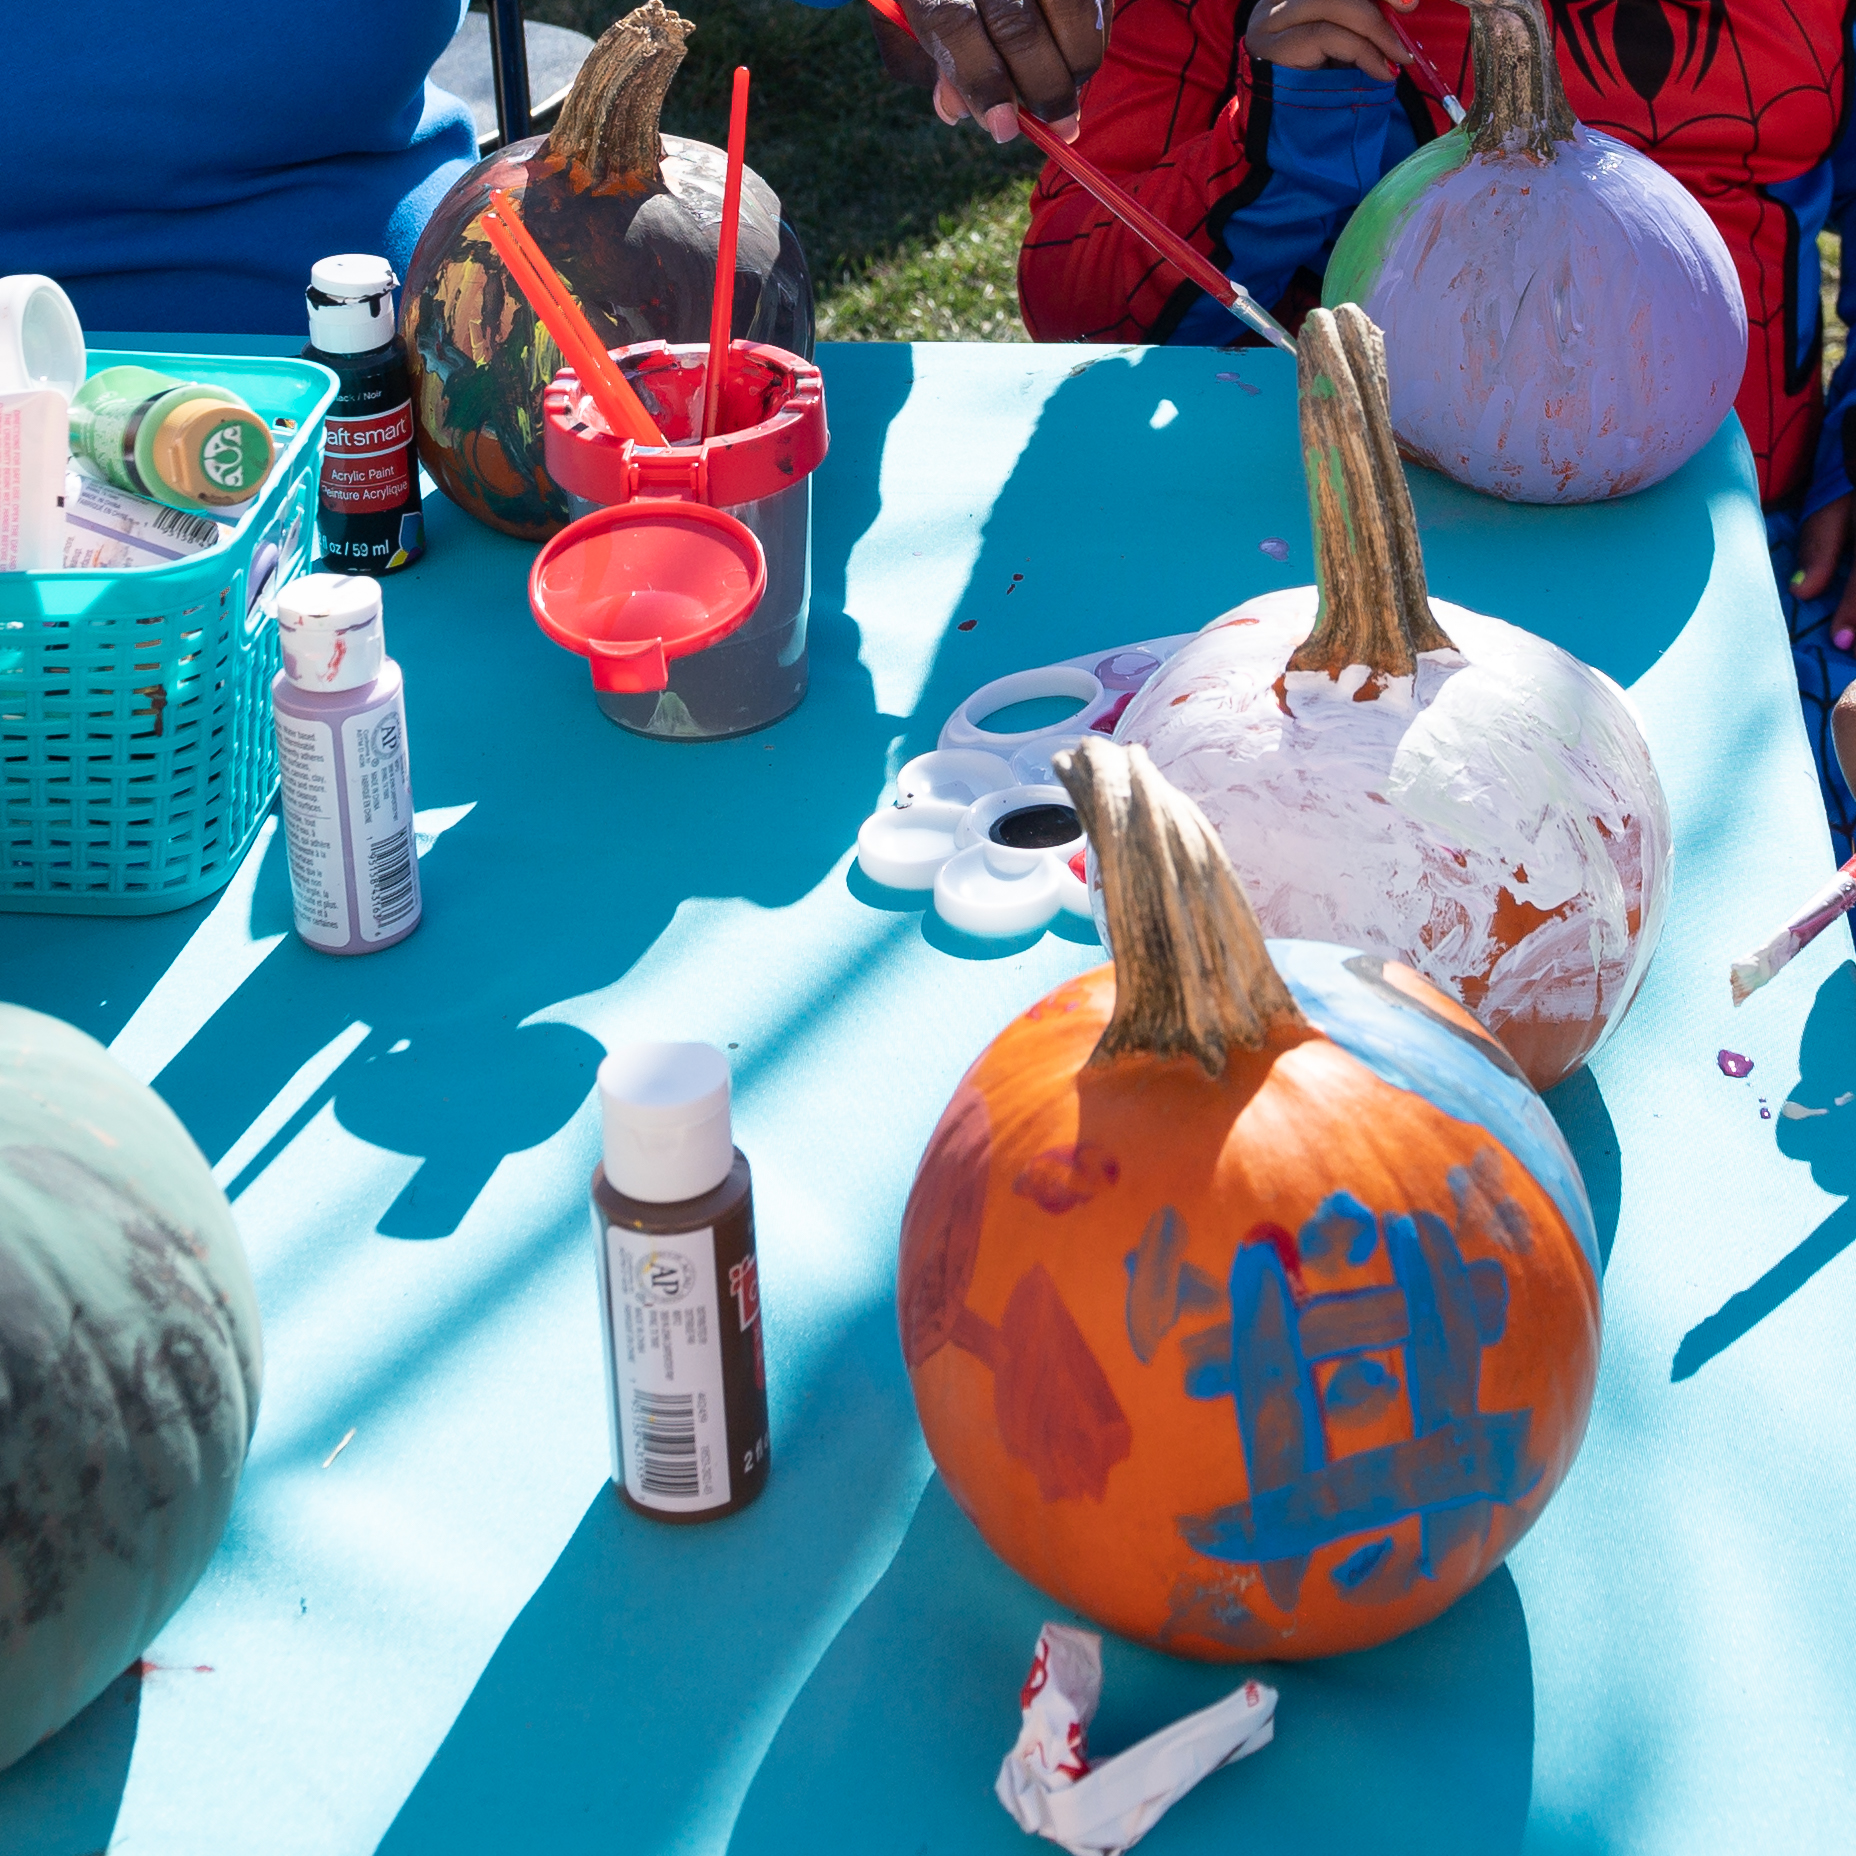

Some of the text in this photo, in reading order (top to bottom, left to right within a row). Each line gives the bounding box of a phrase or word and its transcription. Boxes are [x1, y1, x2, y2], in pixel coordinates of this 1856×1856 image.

[364, 390, 382, 400] Noir
[332, 466, 394, 484] Acrylic Paint
[322, 480, 408, 500] Peinture Acrylique
[330, 543, 341, 554] oz
[353, 544, 369, 556] 59
[373, 540, 389, 556] ml
[381, 725, 397, 749] AP
[651, 1264, 679, 1295] AP
[744, 1450, 754, 1474] 2
